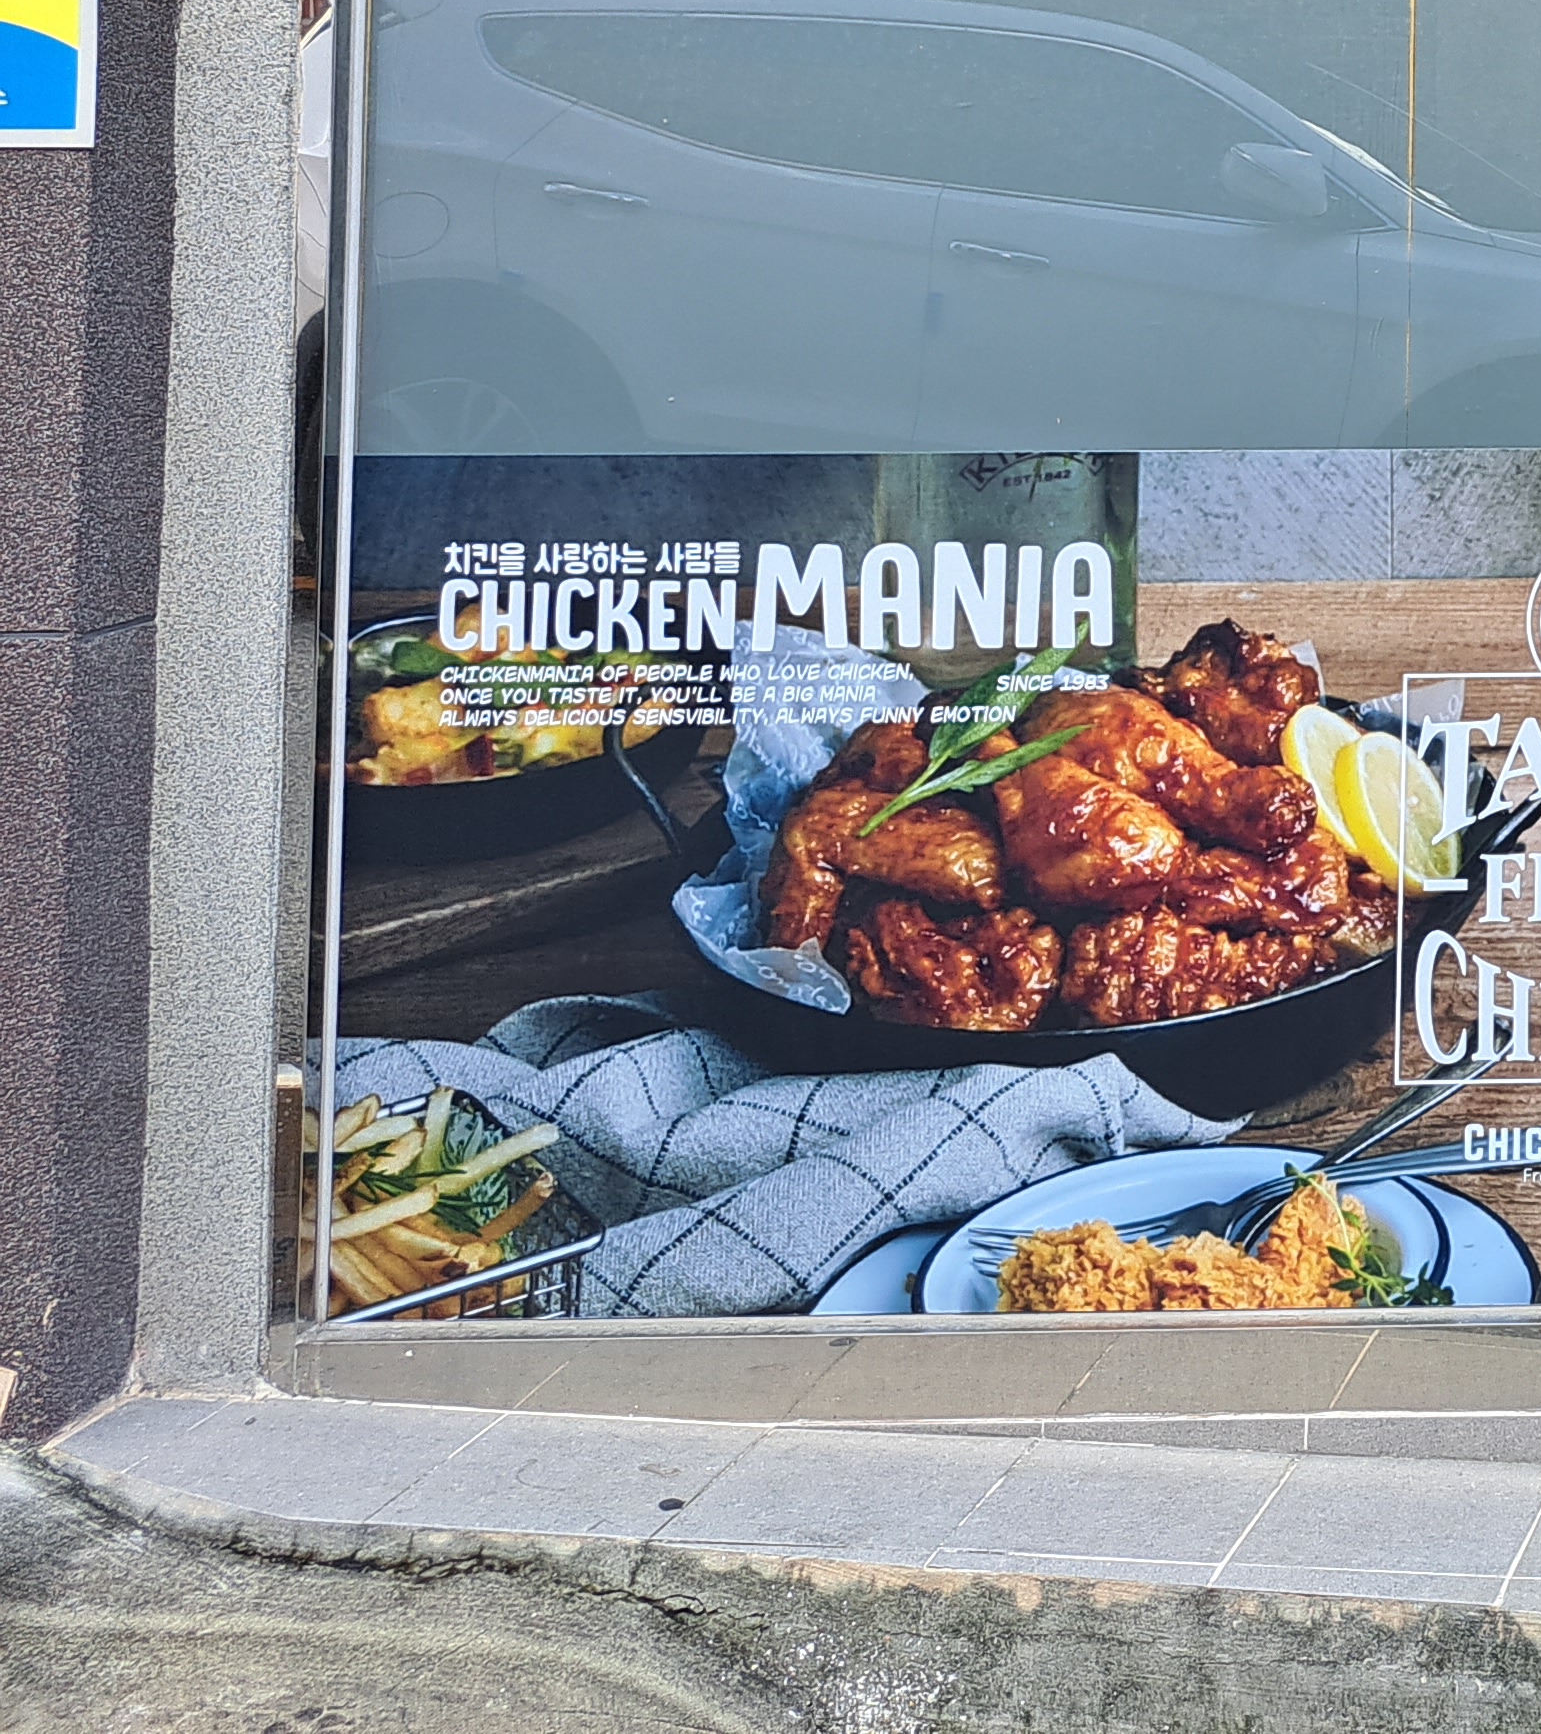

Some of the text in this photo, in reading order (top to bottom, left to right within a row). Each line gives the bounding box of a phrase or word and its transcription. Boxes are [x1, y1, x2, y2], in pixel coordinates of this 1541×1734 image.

[443, 540, 741, 576] 치킨을 사랑하는 사람들
[438, 541, 1114, 653] CHICKEN MANIA
[440, 663, 915, 683] CHICKENMANIA OF PEOPLE WHO LOVE CHICKEN,
[996, 674, 1110, 692] SINCE 1983
[440, 685, 876, 705] ONCE YOU TASTE IT, YOU'LL BE A BIG MANIA
[438, 706, 1017, 727] ALWAYS DELICIOUS SENSVIBILITY, ALWAYS FUNNY EMOTION
